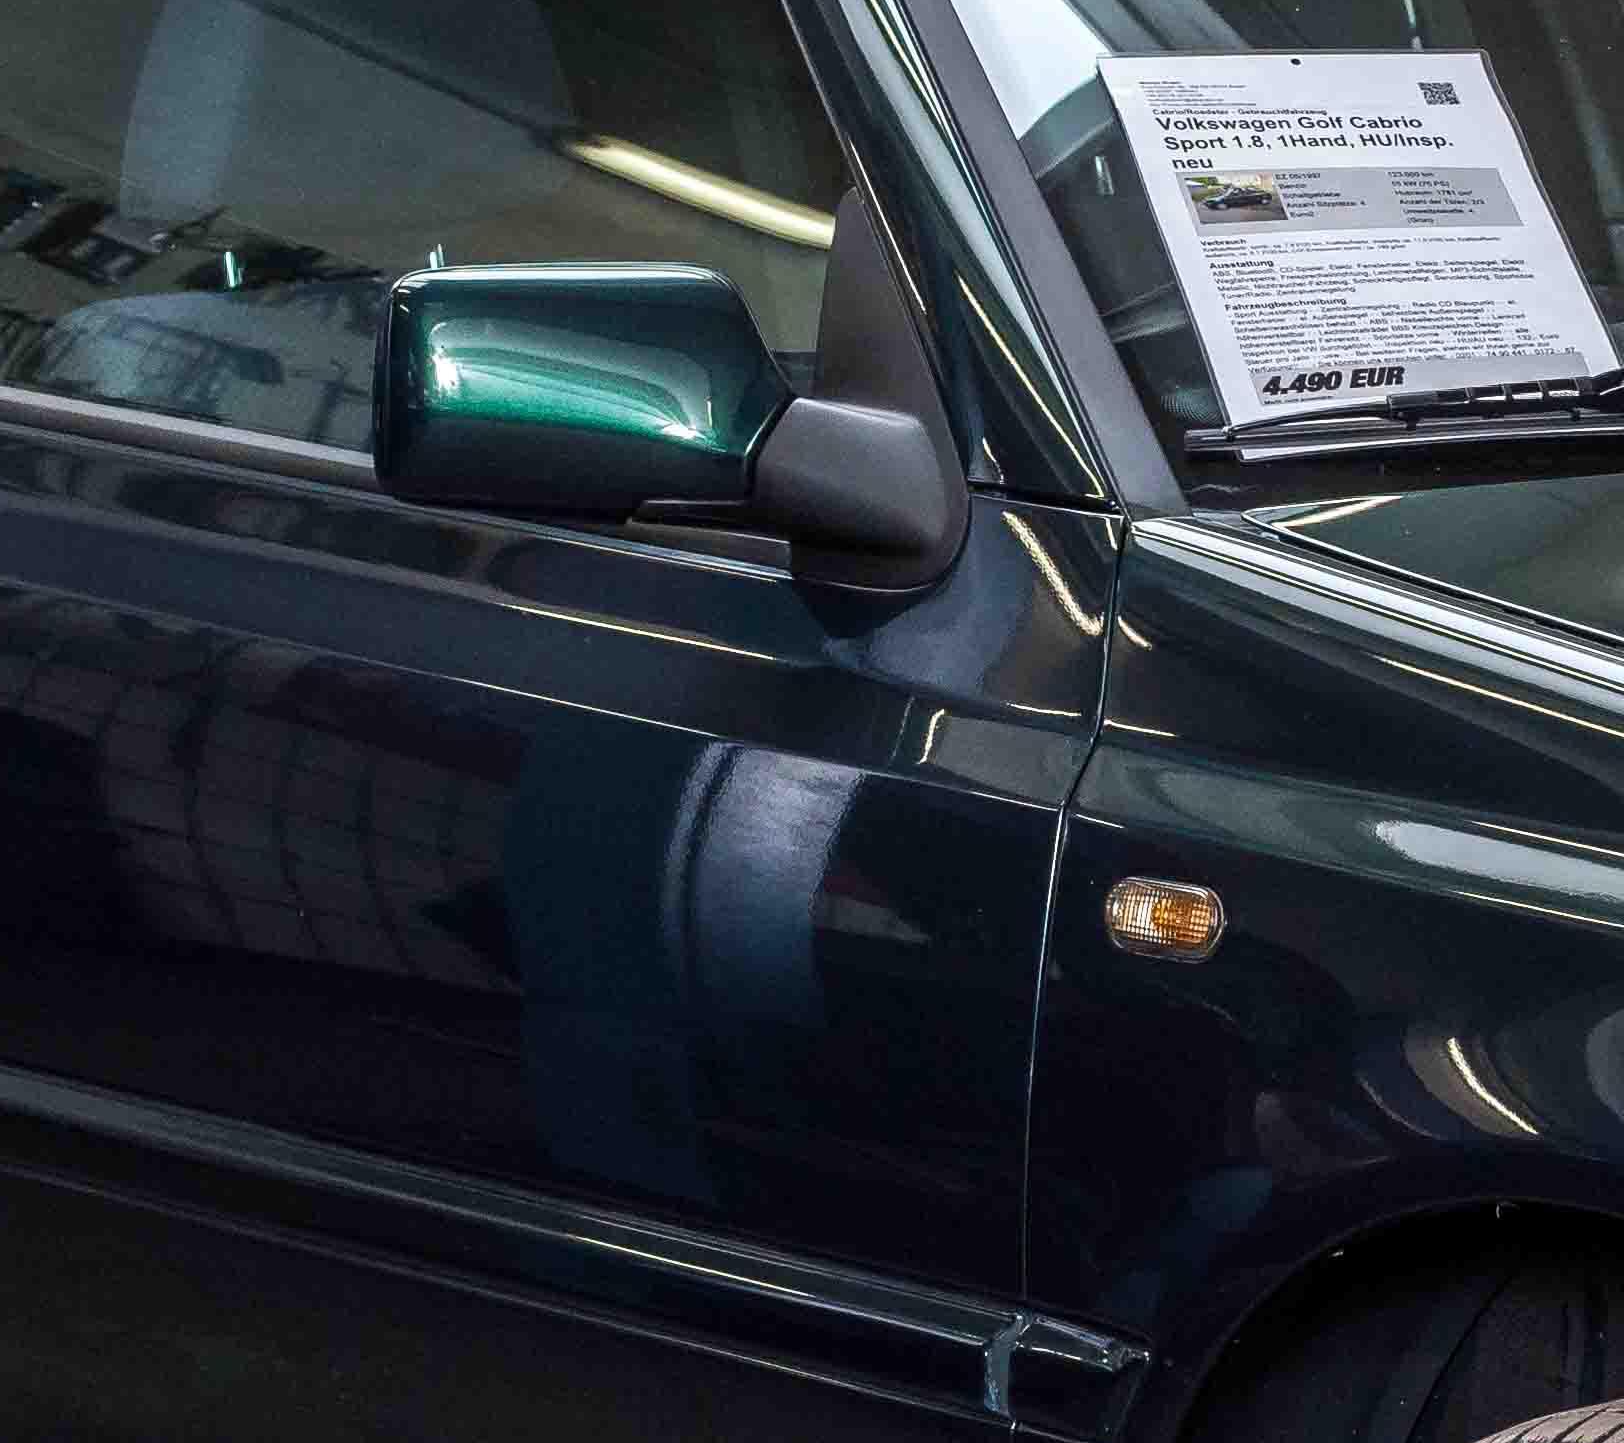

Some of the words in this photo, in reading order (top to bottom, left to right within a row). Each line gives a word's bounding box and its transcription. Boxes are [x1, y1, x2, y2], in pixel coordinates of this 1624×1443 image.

[1155, 117, 1292, 133] Volkswagen
[1298, 116, 1343, 130] Golf
[1350, 116, 1423, 129] Cabrio
[1164, 136, 1227, 152] Sport
[1231, 135, 1272, 150] 1.8,
[1277, 134, 1355, 149] 1Hand,
[1359, 133, 1455, 150] HU/Insp.
[1172, 158, 1214, 169] neu
[1209, 259, 1275, 269] Ausstattung
[1224, 297, 1347, 311] Fahrzeugbeschreibung
[1262, 369, 1344, 396] 4.490
[1349, 365, 1405, 389] EUR
